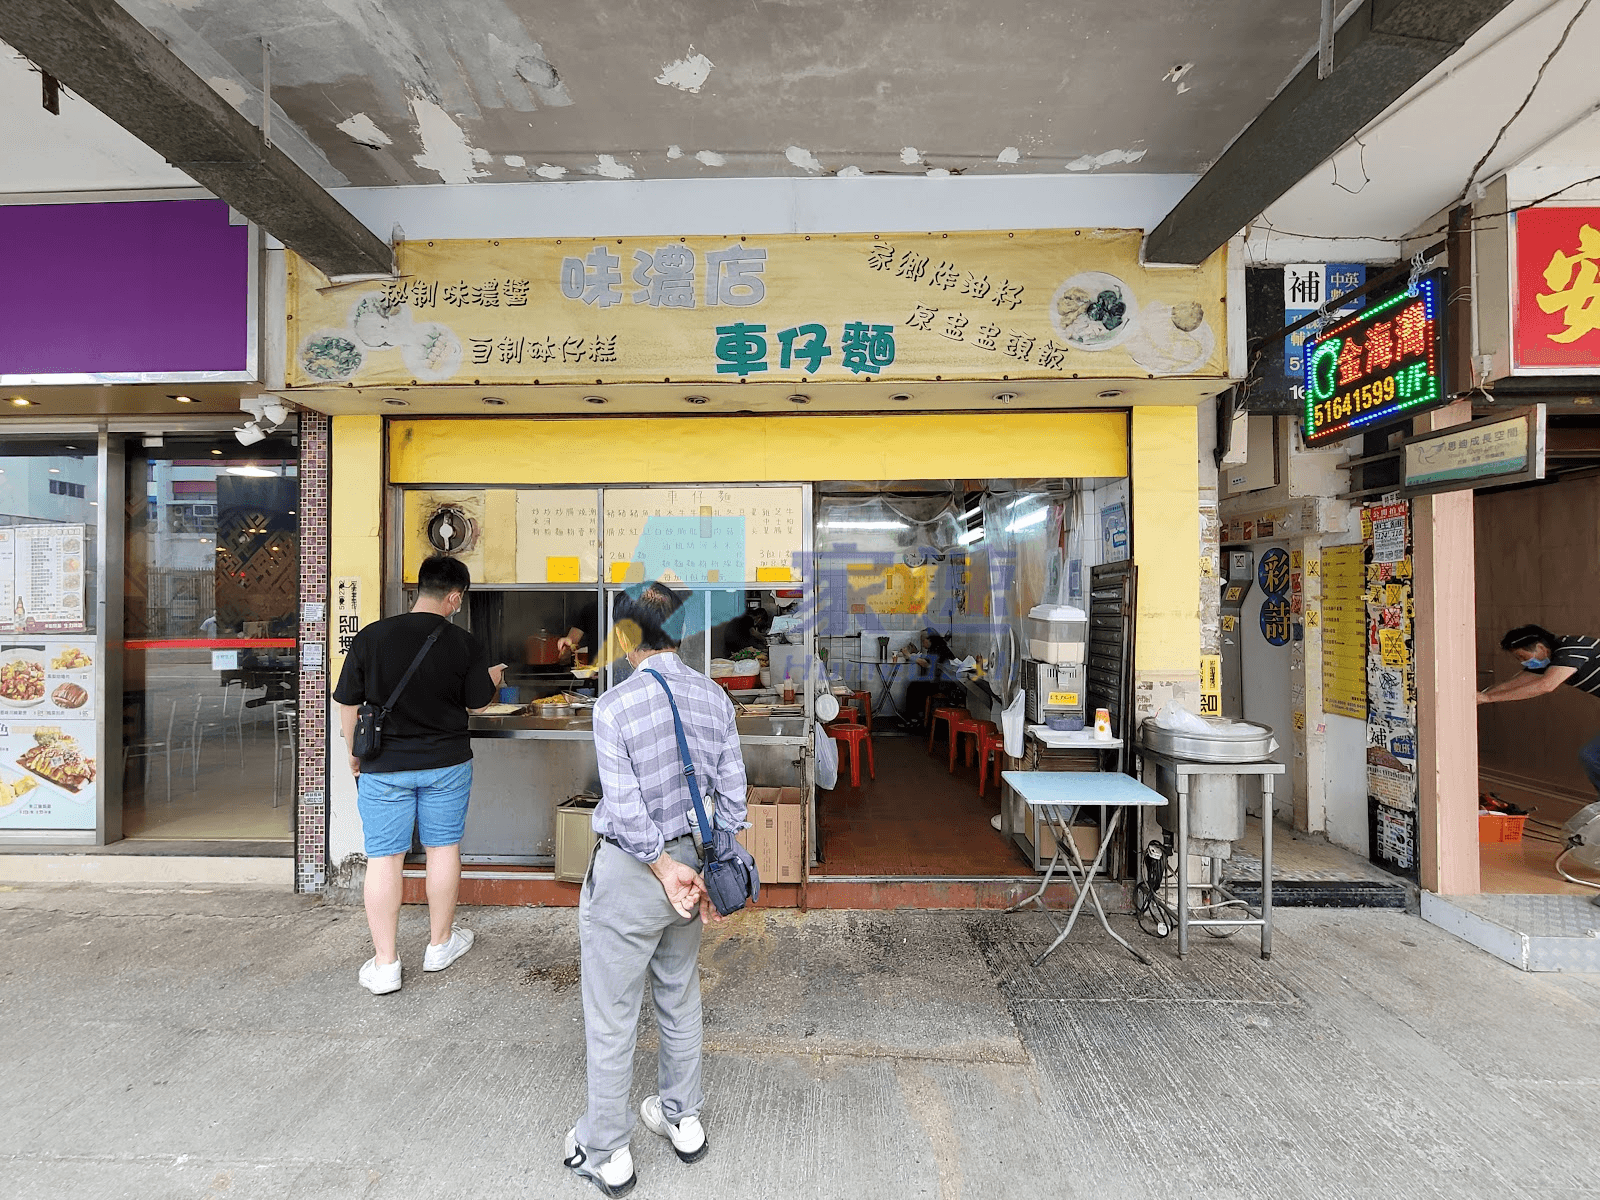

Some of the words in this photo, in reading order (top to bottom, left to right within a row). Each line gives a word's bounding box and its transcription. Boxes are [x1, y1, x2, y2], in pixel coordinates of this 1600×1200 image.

[561, 244, 768, 309] 味濃店
[1288, 270, 1320, 304] 補
[1330, 272, 1360, 288] 中英
[715, 320, 896, 376] 車仔麵
[1313, 376, 1395, 426] 51641599
[1395, 361, 1427, 398] 1/F
[1263, 554, 1290, 641] 彩詩
